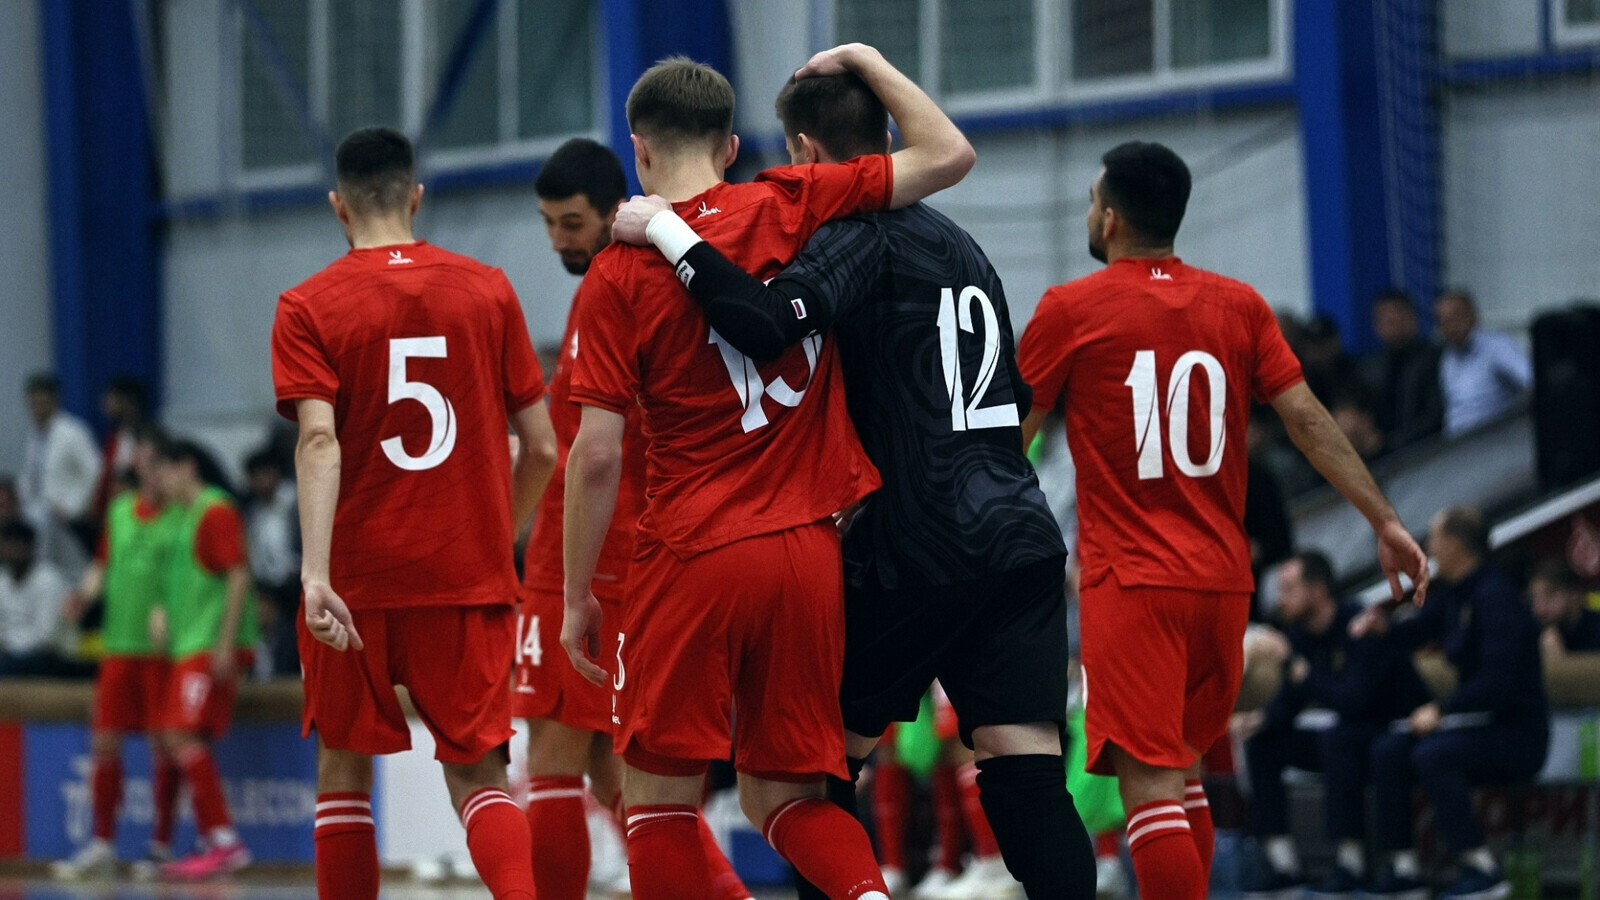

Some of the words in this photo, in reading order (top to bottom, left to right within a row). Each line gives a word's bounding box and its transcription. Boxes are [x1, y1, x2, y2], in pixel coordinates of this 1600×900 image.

[380, 335, 457, 471] 5
[936, 285, 1020, 431] 12
[1124, 350, 1227, 480] 10
